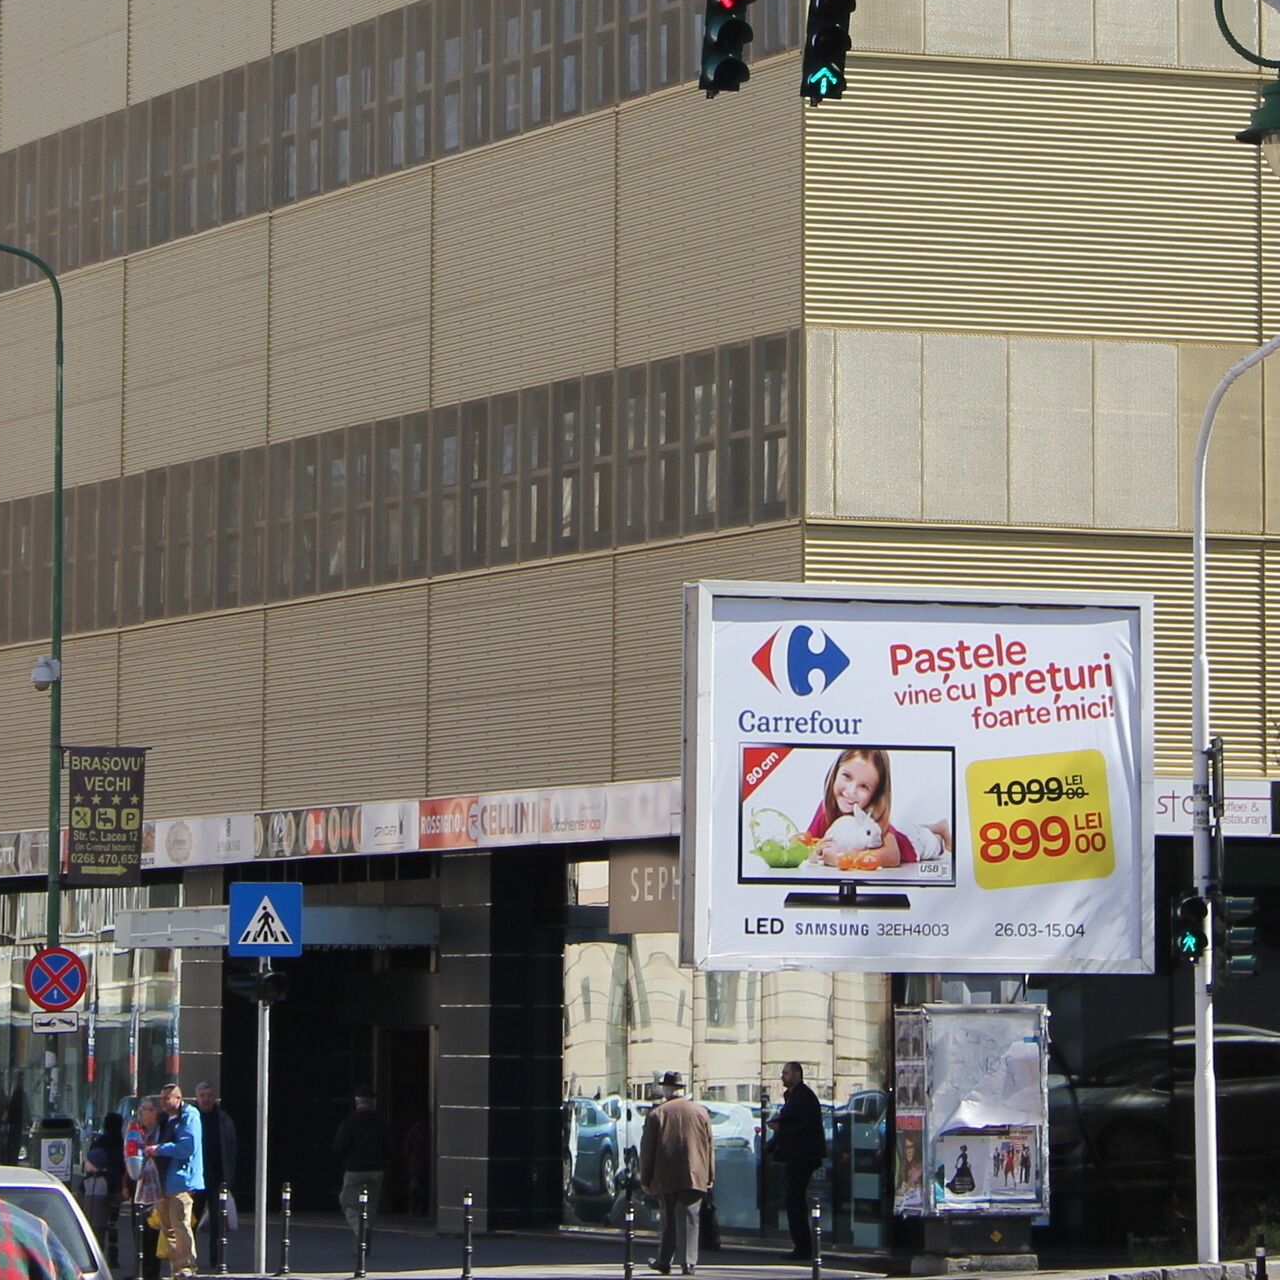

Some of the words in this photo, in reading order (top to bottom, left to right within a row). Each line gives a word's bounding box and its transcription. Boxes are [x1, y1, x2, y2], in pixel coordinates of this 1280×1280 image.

[894, 683, 943, 707] vine
[946, 682, 976, 702] cu
[738, 709, 864, 736] Carrefour
[971, 704, 1052, 730] foarte
[1056, 694, 1116, 722] mici!
[745, 767, 764, 786] 80
[761, 751, 780, 772] cm
[84, 776, 131, 792] VECHI
[985, 776, 1064, 807] 1.099
[1065, 774, 1083, 786] LEI
[1065, 786, 1086, 800] 00
[1221, 802, 1248, 813] offee
[480, 800, 537, 837] CELLINI
[1220, 815, 1269, 826] estaurant
[73, 830, 89, 841] Str.
[129, 831, 139, 841] 12
[979, 815, 1072, 864] 899
[1073, 811, 1103, 831] LEI
[1074, 832, 1107, 854] 00
[919, 864, 939, 874] USB
[743, 917, 785, 936] LED
[795, 922, 870, 937] SAMSUNG
[876, 922, 950, 938] 32EH4003
[994, 922, 1086, 939] 26.03-15.04
